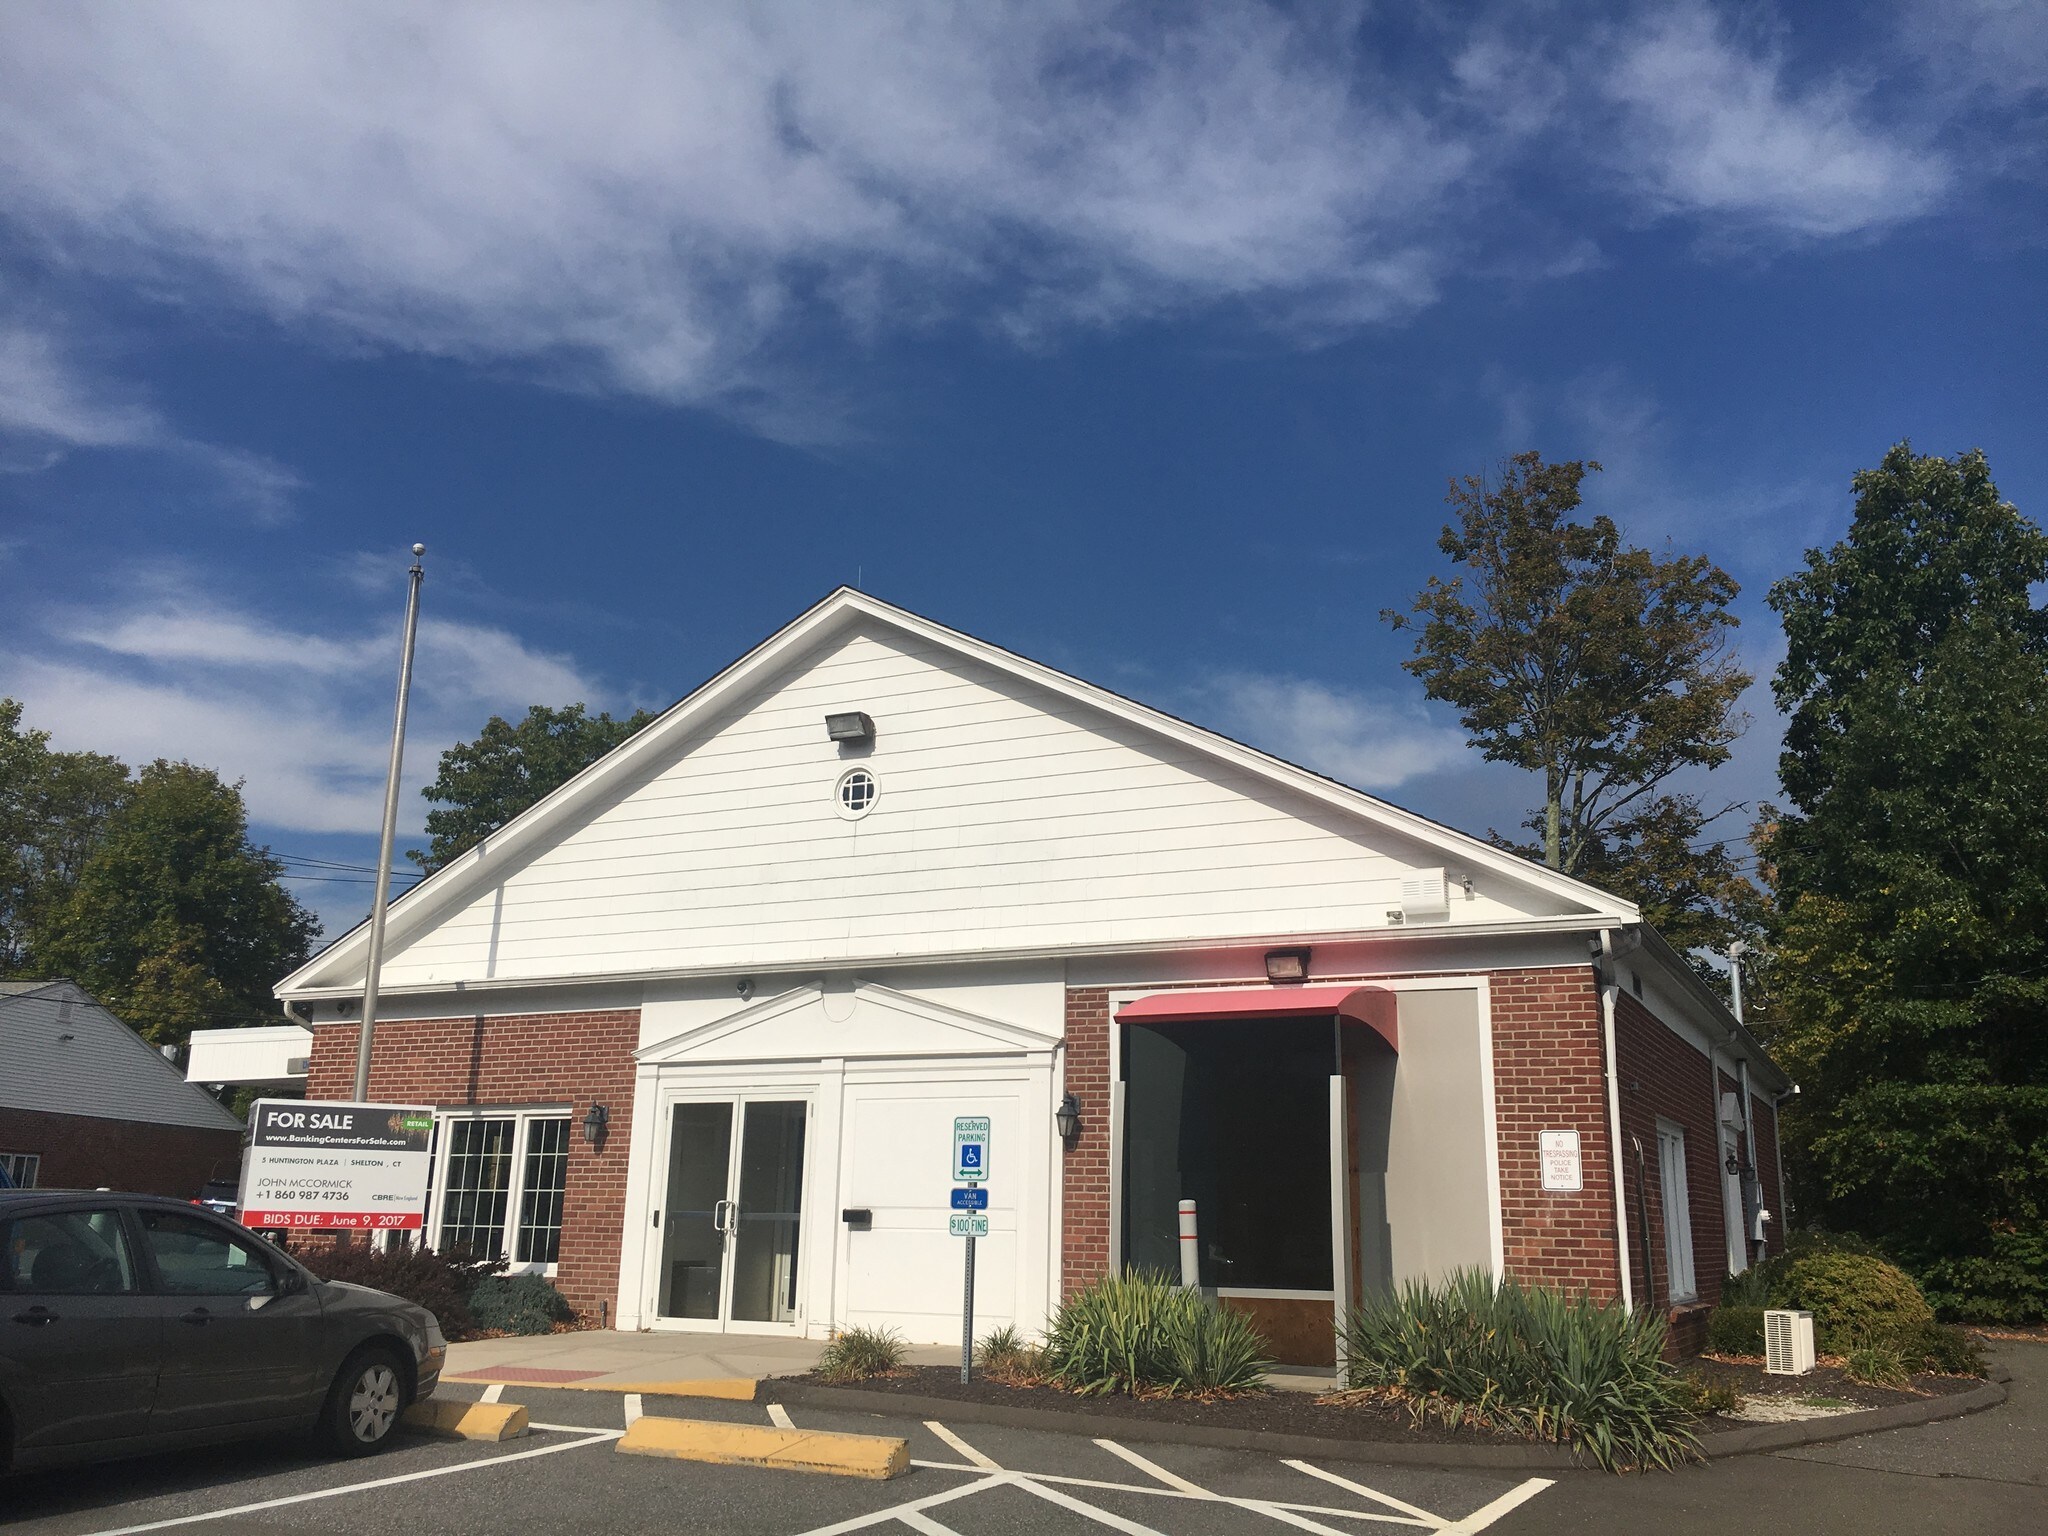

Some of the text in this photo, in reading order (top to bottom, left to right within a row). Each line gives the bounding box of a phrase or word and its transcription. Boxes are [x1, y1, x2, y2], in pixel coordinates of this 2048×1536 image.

[267, 1112, 353, 1130] FOR SALE
[957, 1123, 988, 1131] RESERVED
[266, 1134, 406, 1146] www.BankingCentersForSale.com
[958, 1134, 985, 1142] PARKING
[258, 1178, 352, 1188] JOHN MCCORMICK
[275, 1191, 295, 1200] 860
[299, 1192, 318, 1200] 987
[322, 1192, 349, 1201] 4736
[264, 1214, 405, 1227] BIDS DUE: June 9, 2017
[951, 1219, 987, 1231] $100 FINE
